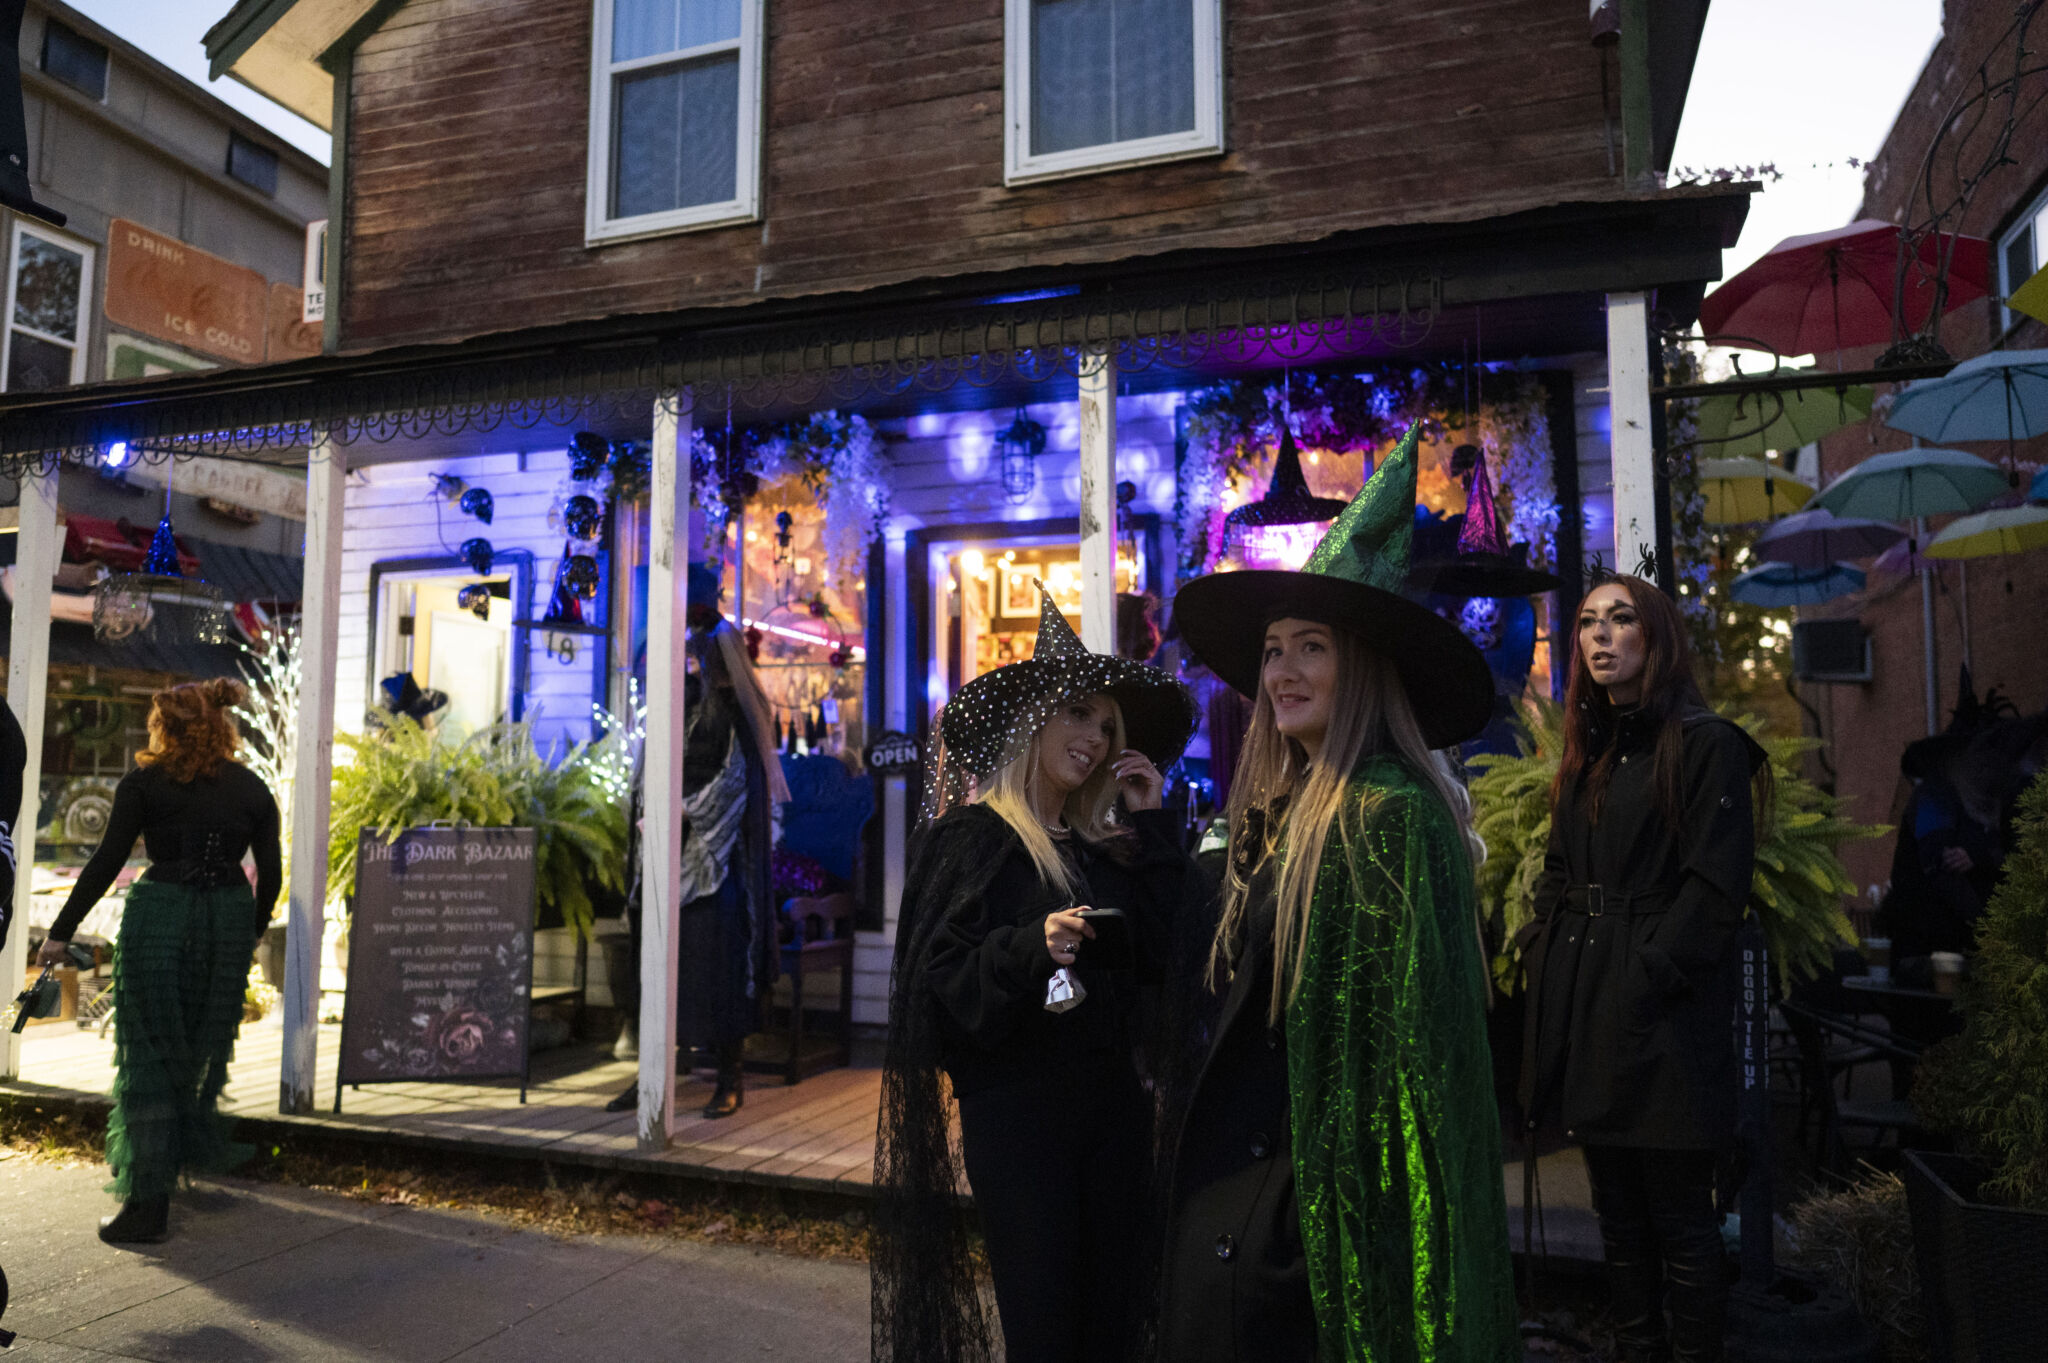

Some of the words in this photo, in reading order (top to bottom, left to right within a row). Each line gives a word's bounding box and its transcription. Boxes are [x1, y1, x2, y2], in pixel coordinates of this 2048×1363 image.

[128, 231, 184, 265] DRINK
[205, 327, 251, 354] COLD
[871, 745, 918, 768] OPEN
[362, 842, 398, 865] THE
[406, 842, 458, 865] DARK
[464, 842, 533, 866] BAZAAR
[1743, 949, 1754, 1016] DOGGY
[1744, 1020, 1754, 1060] TIE
[1744, 1064, 1755, 1090] UP
